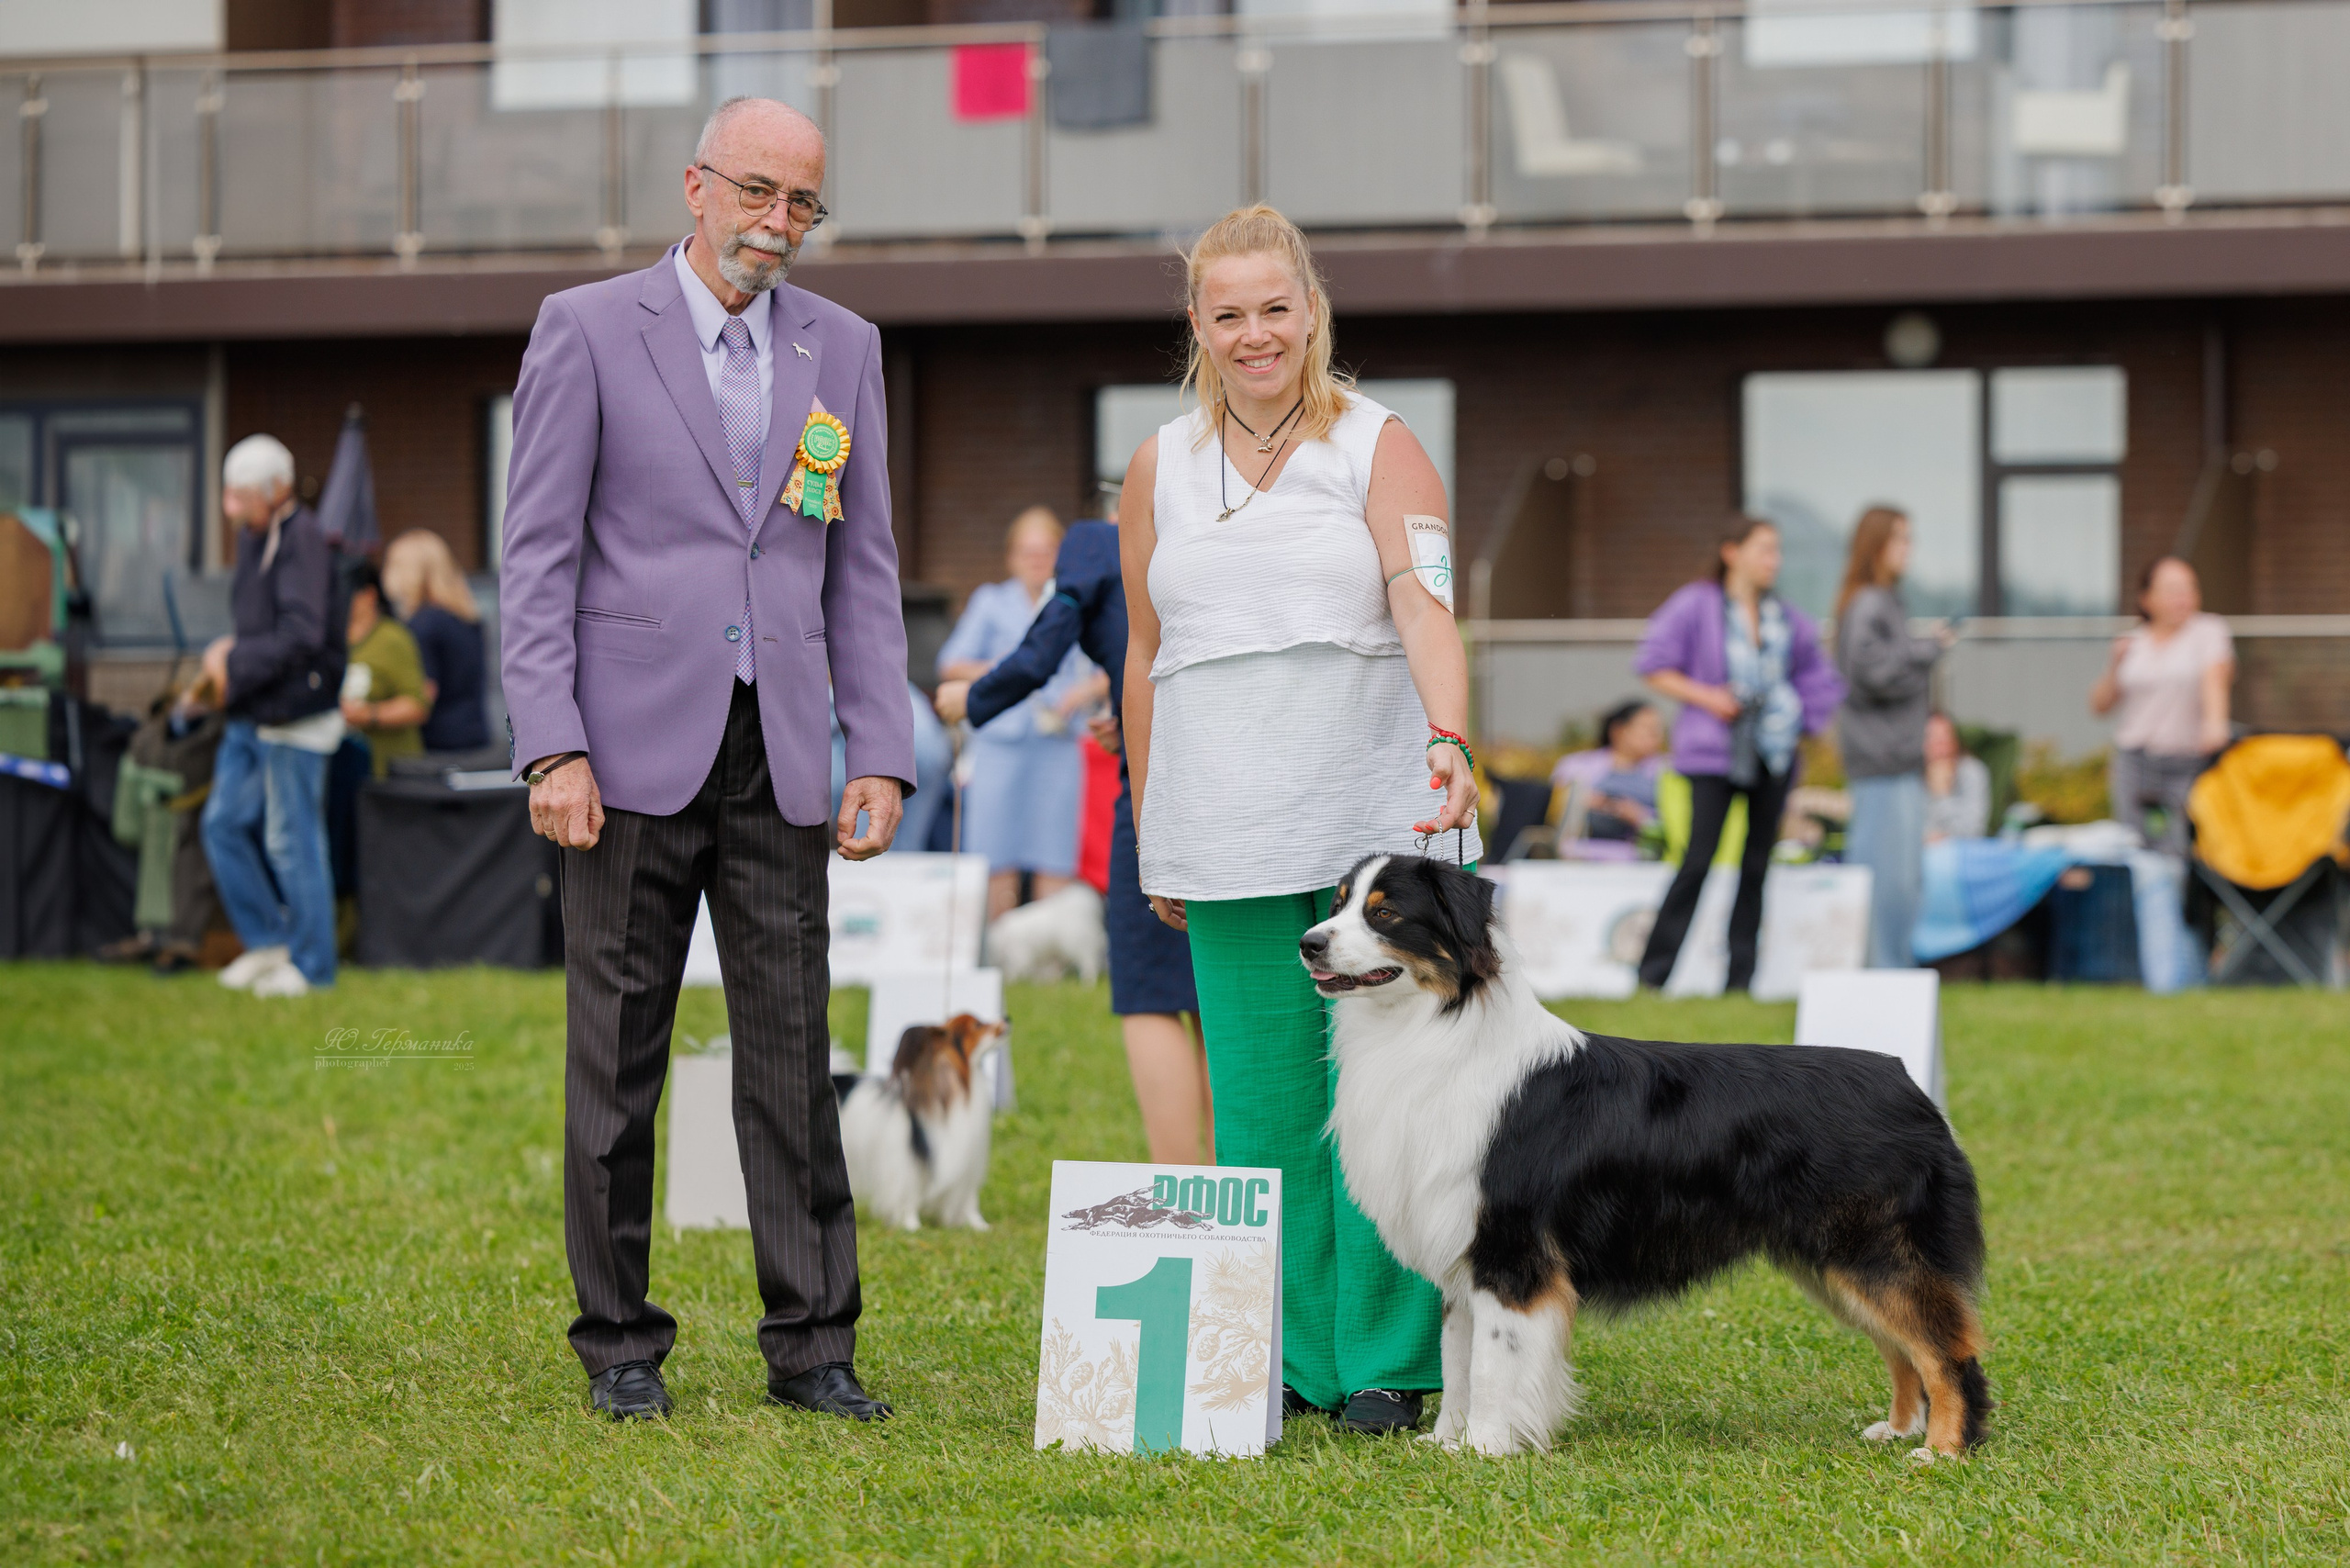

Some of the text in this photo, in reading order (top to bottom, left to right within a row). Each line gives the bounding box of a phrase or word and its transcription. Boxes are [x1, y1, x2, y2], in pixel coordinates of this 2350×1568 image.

[806, 487, 822, 496] JUDGE
[1153, 1174, 1270, 1227] РФОС
[1090, 1230, 1267, 1243] ФЕДЕРАЦИЯ ОХОТНИЧЬЕГО СОБАКОВОДСТВА
[1095, 1257, 1193, 1458] 1
